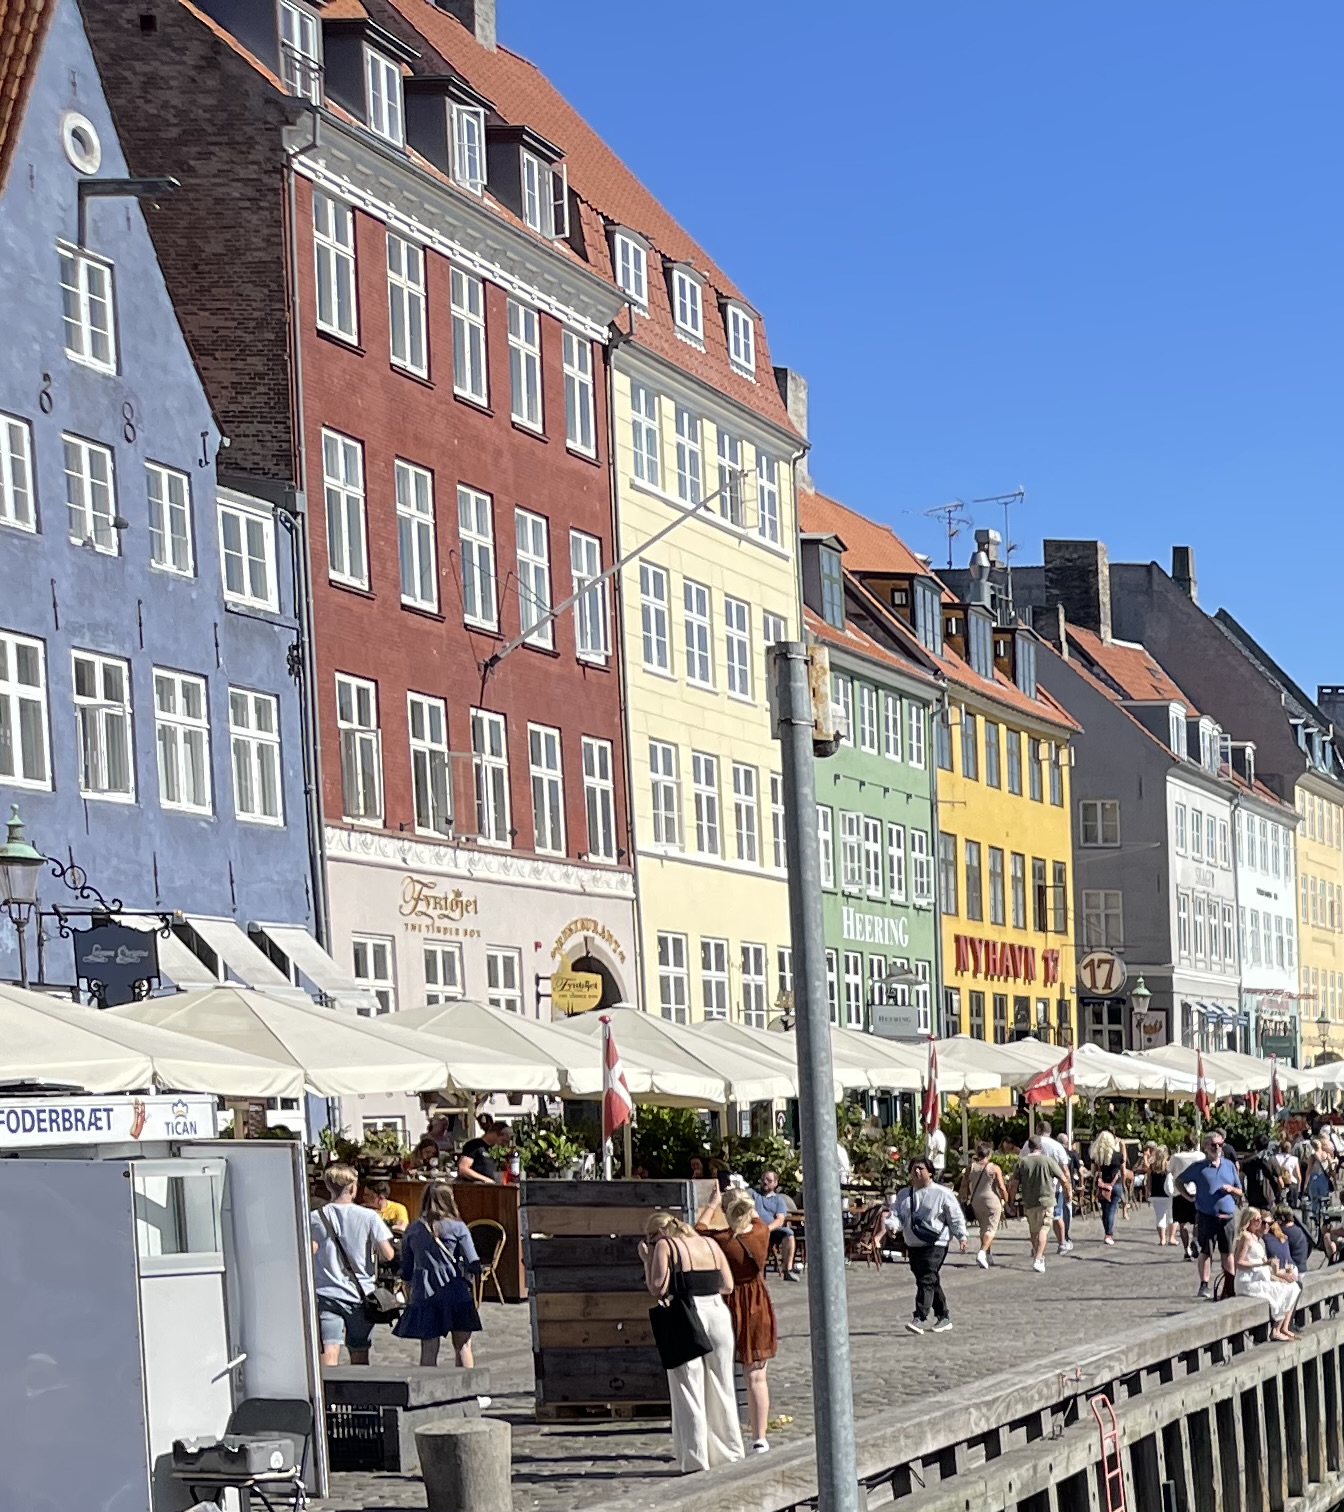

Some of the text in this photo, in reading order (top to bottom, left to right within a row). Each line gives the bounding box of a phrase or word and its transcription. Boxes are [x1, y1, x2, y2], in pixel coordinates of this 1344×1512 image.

[841, 905, 910, 948] HEERING
[954, 934, 1061, 987] NYHAVN 17
[1081, 957, 1117, 991] 17
[164, 1120, 198, 1136] TICAN
